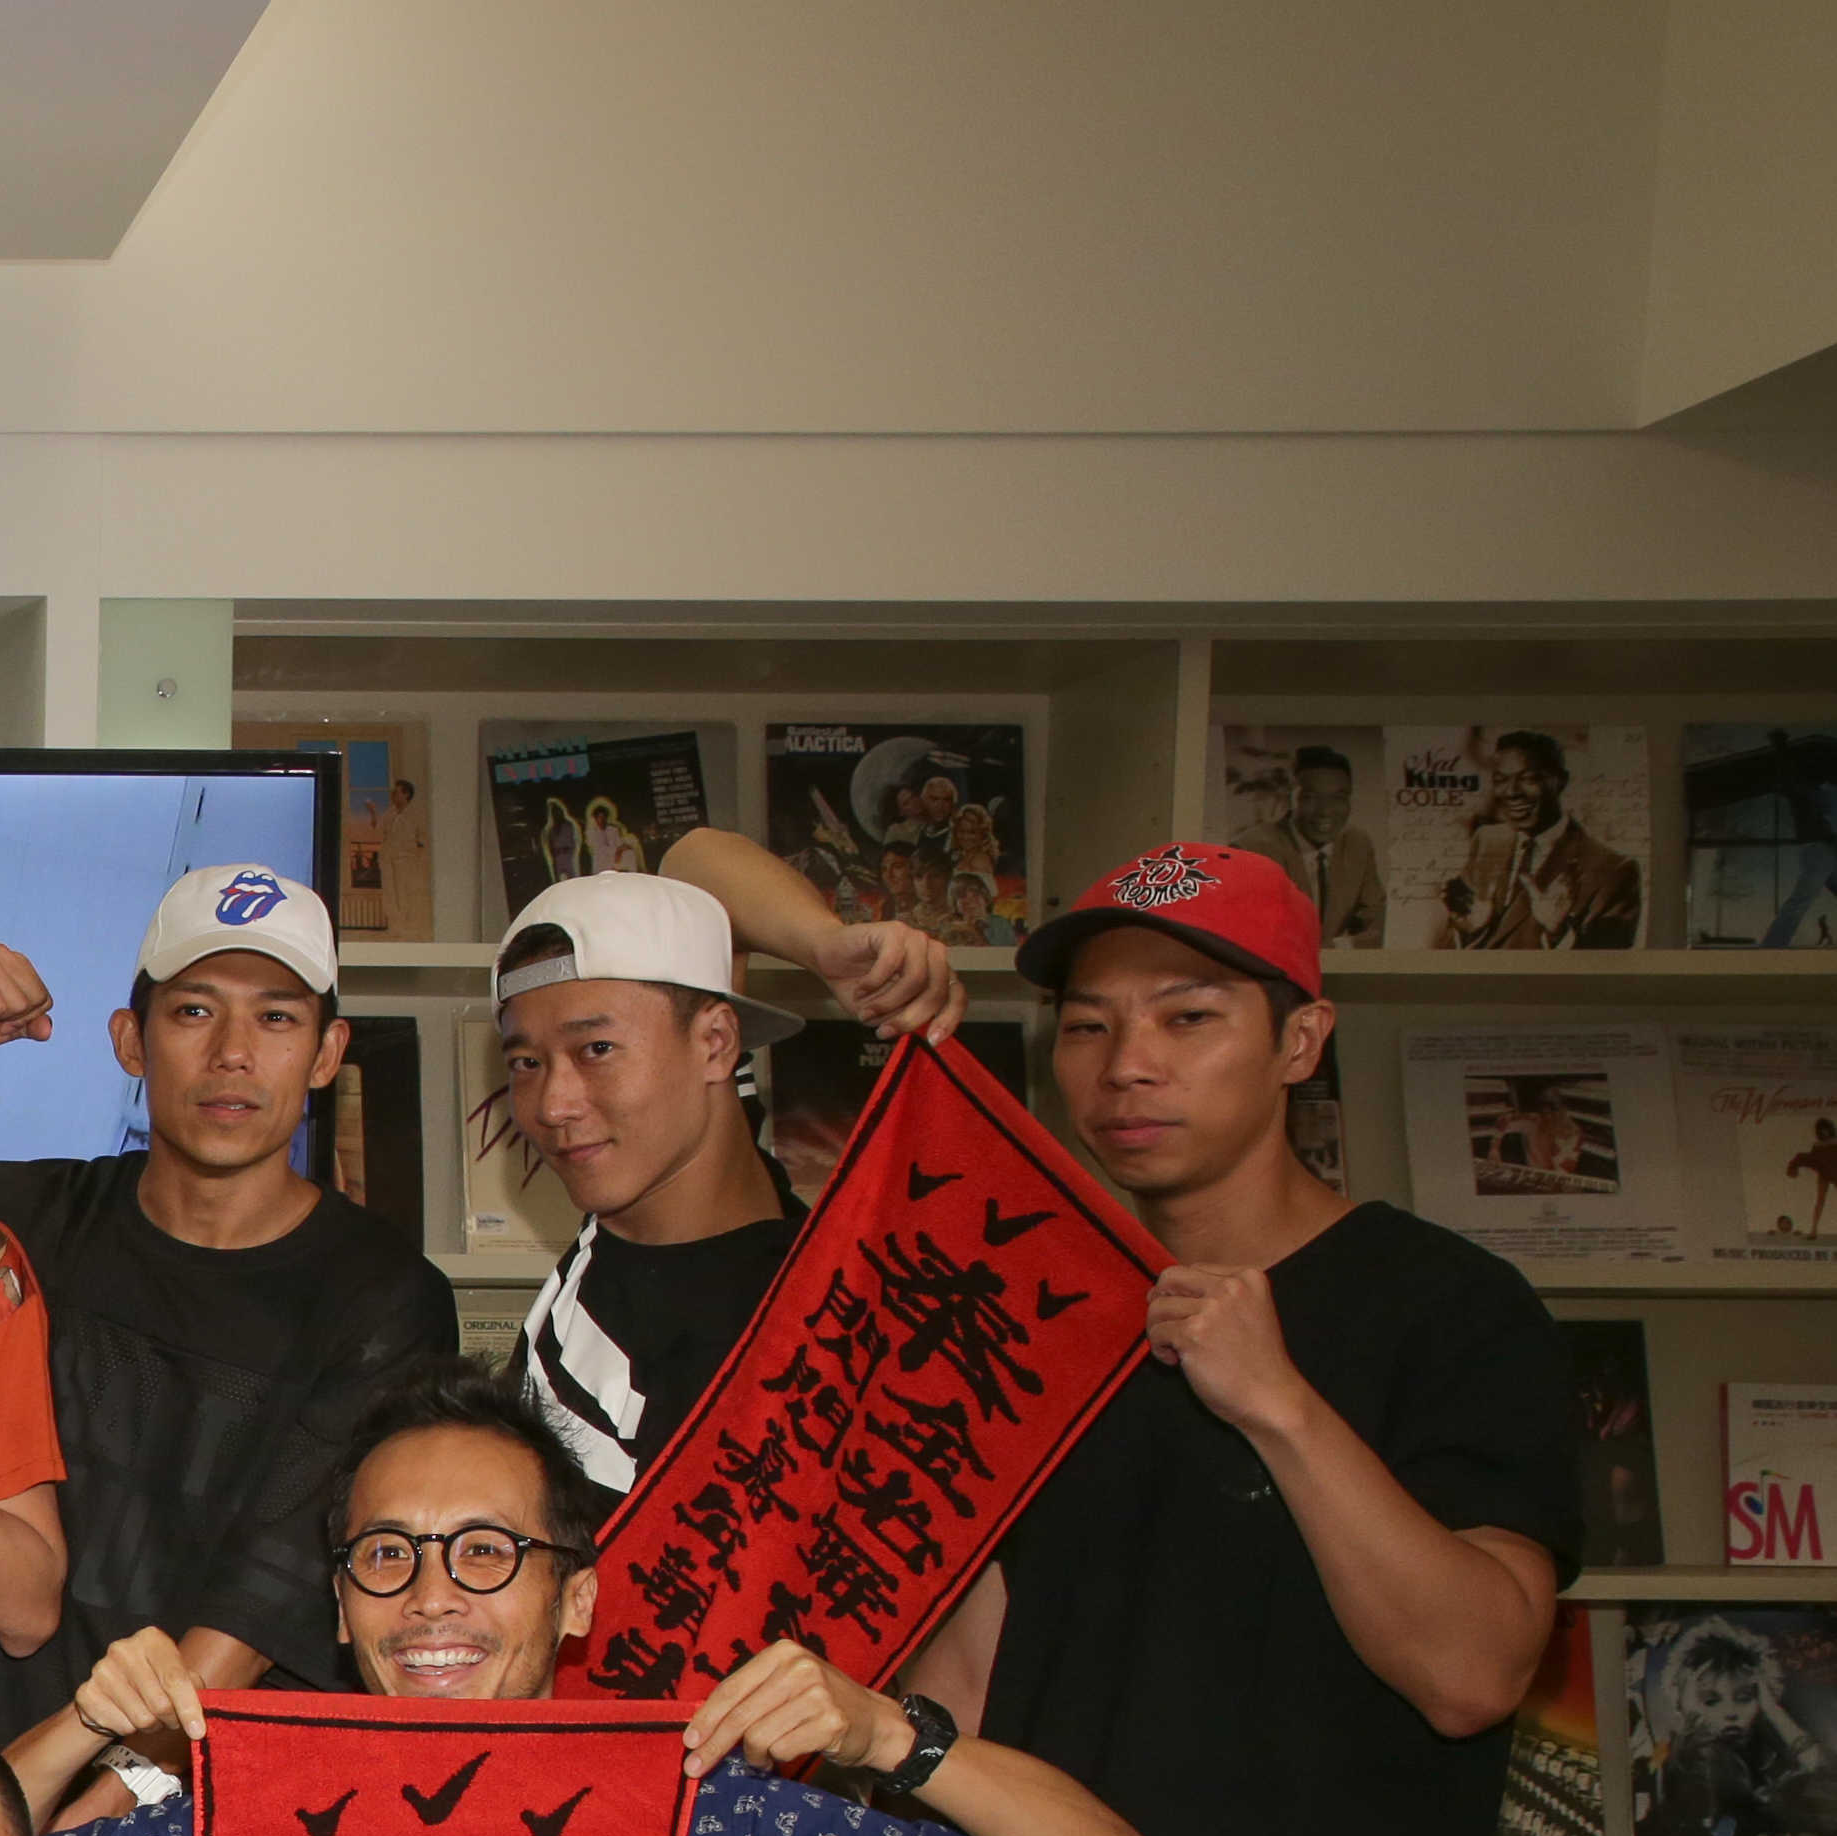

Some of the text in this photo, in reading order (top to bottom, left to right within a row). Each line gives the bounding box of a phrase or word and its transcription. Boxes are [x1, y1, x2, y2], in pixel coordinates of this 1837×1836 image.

[782, 735, 866, 753] ALACTICA
[1405, 769, 1479, 791] King
[1396, 788, 1463, 807] COLE
[463, 1321, 518, 1330] ORIGINAL
[857, 1230, 1043, 1425] 奉
[1728, 1482, 1824, 1561] SM
